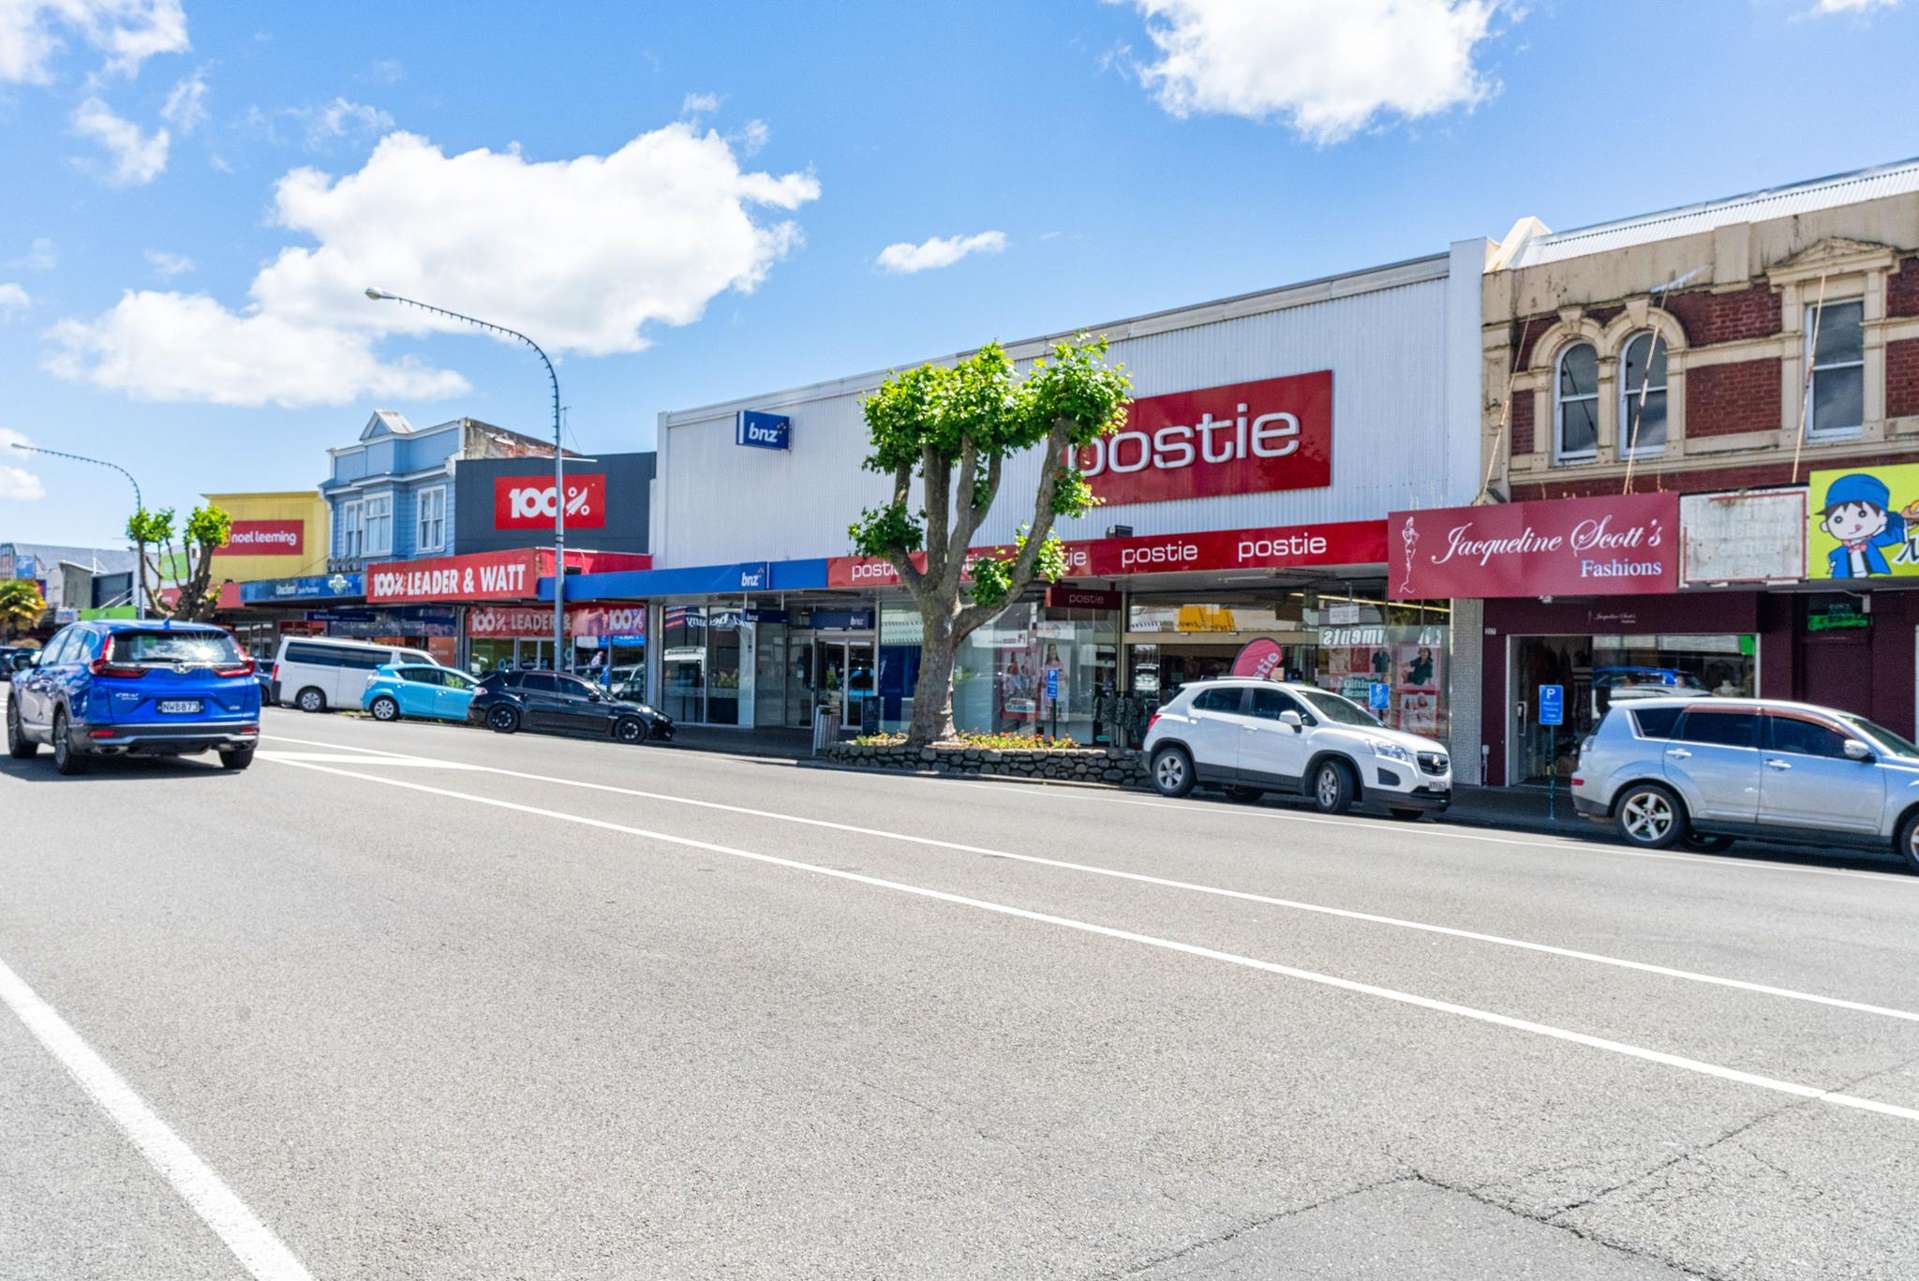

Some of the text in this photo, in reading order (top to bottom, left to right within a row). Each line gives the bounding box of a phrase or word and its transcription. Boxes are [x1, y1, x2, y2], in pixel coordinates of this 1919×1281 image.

[748, 422, 778, 443] bnz
[1067, 402, 1300, 477] postie
[508, 486, 590, 518] 100%
[231, 530, 296, 546] noel leeming
[1238, 532, 1327, 562] postie
[1431, 521, 1563, 566] Jacqueline
[1570, 514, 1662, 557] Scott's
[1121, 540, 1198, 568] postie
[1580, 558, 1662, 578] Fashions
[373, 563, 526, 597] 100% LEADER & WATT
[741, 571, 759, 587] bnz
[1069, 593, 1104, 604] postie
[472, 613, 507, 632] 100%
[608, 608, 643, 630] 100%
[1546, 688, 1556, 699] P
